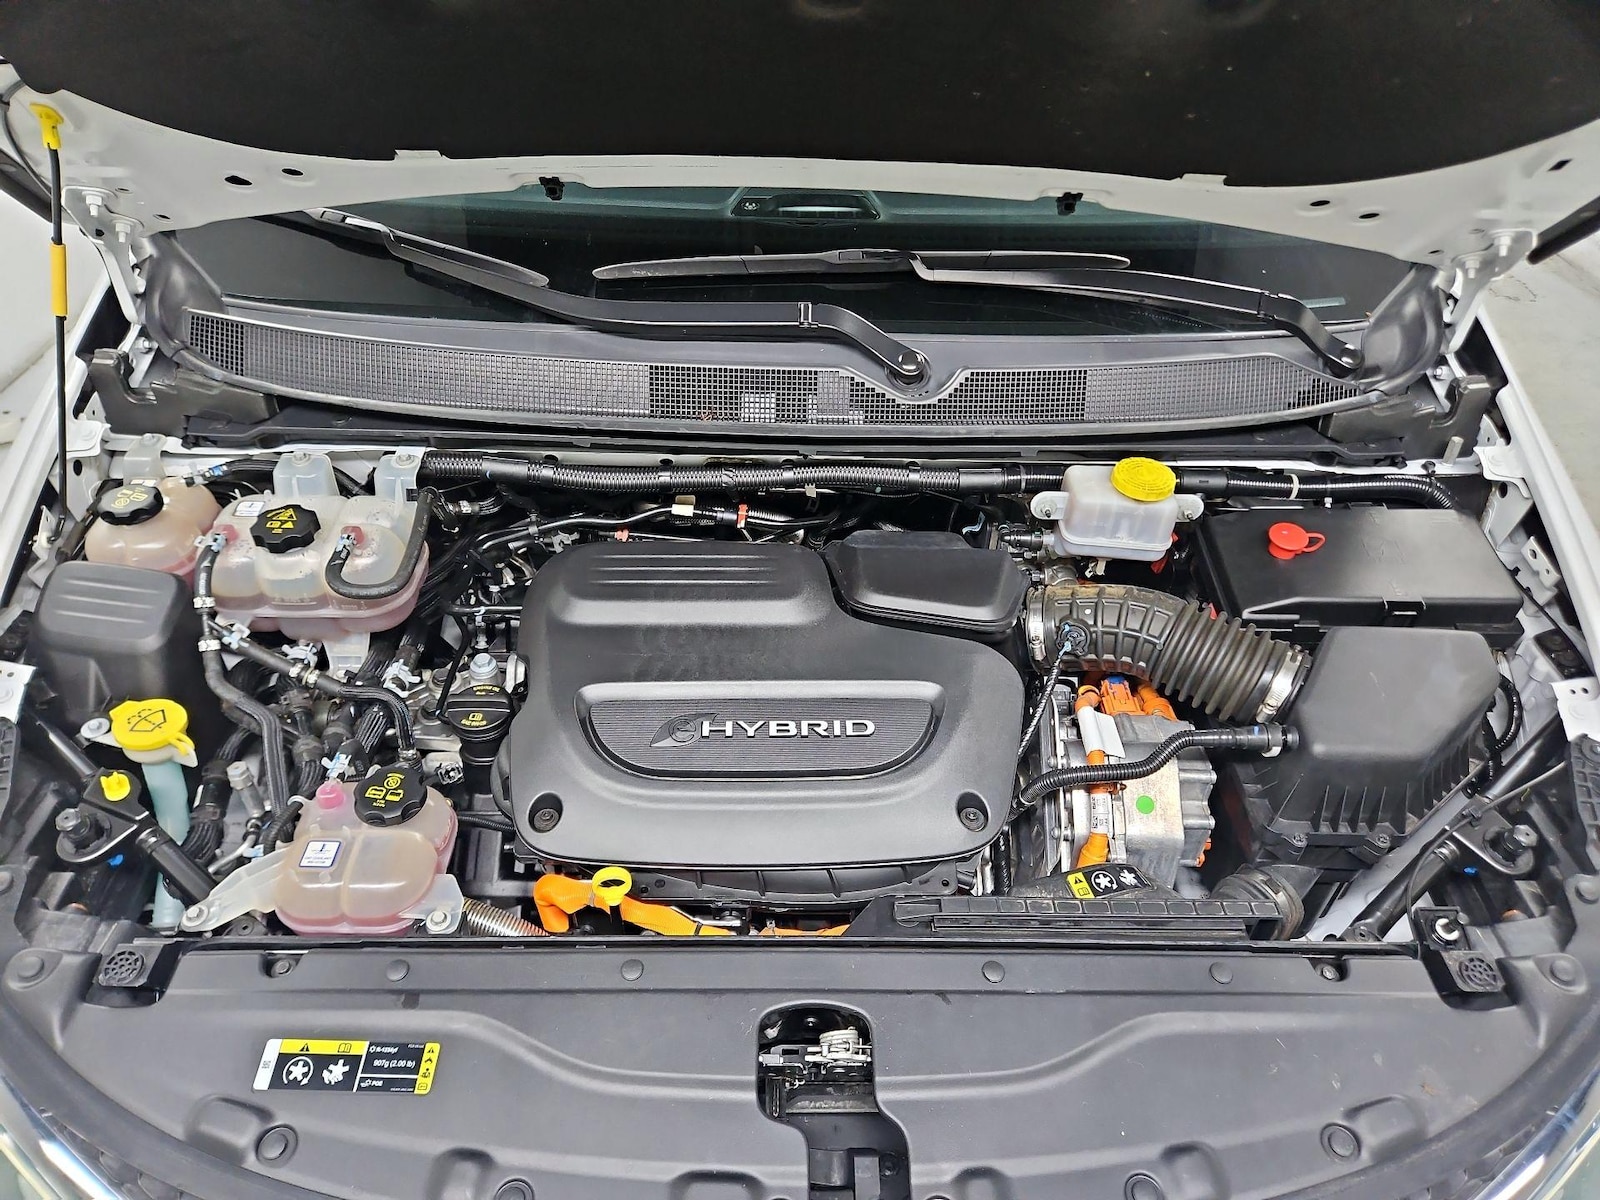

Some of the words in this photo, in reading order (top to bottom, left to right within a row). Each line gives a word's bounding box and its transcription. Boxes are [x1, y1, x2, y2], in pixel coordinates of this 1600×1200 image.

[702, 719, 876, 738] HYBRID
[373, 1059, 389, 1069] 907g
[390, 1059, 406, 1068] (2.00
[407, 1060, 416, 1069] lb)
